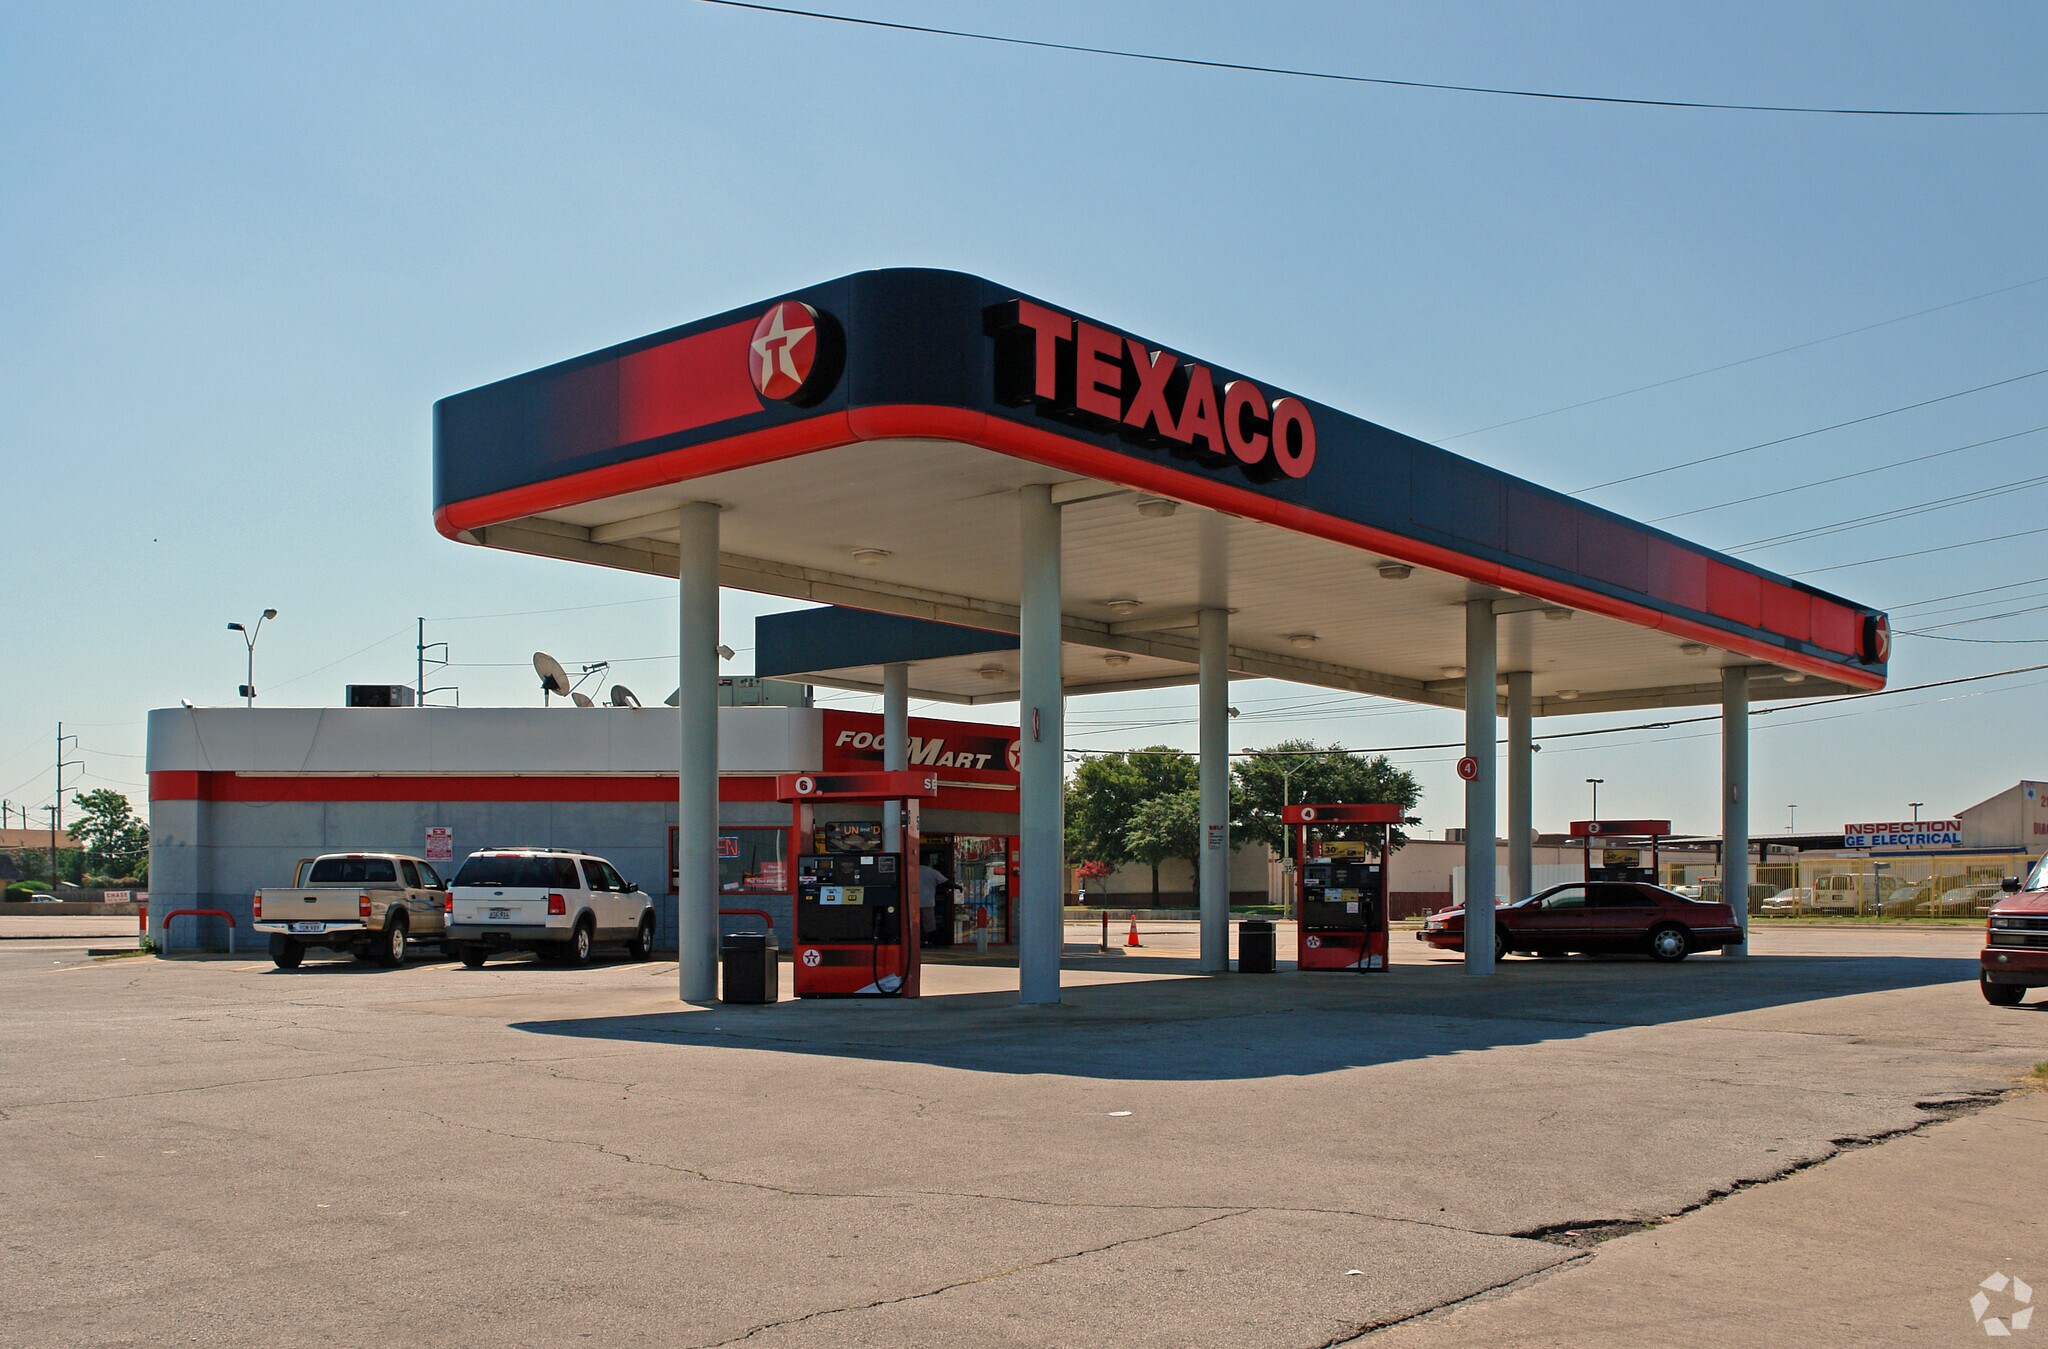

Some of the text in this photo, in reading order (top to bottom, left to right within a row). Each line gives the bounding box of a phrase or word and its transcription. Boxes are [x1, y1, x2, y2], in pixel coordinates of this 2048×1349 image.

[1016, 298, 1316, 479] TEXACO
[835, 730, 911, 752] FOO
[1464, 764, 1471, 773] 4
[799, 780, 808, 791] 6
[1304, 810, 1312, 818] 4
[1591, 824, 1597, 832] 2
[1844, 820, 1960, 835] INSPECTION
[1846, 833, 1961, 846] GE ELECTRICAL
